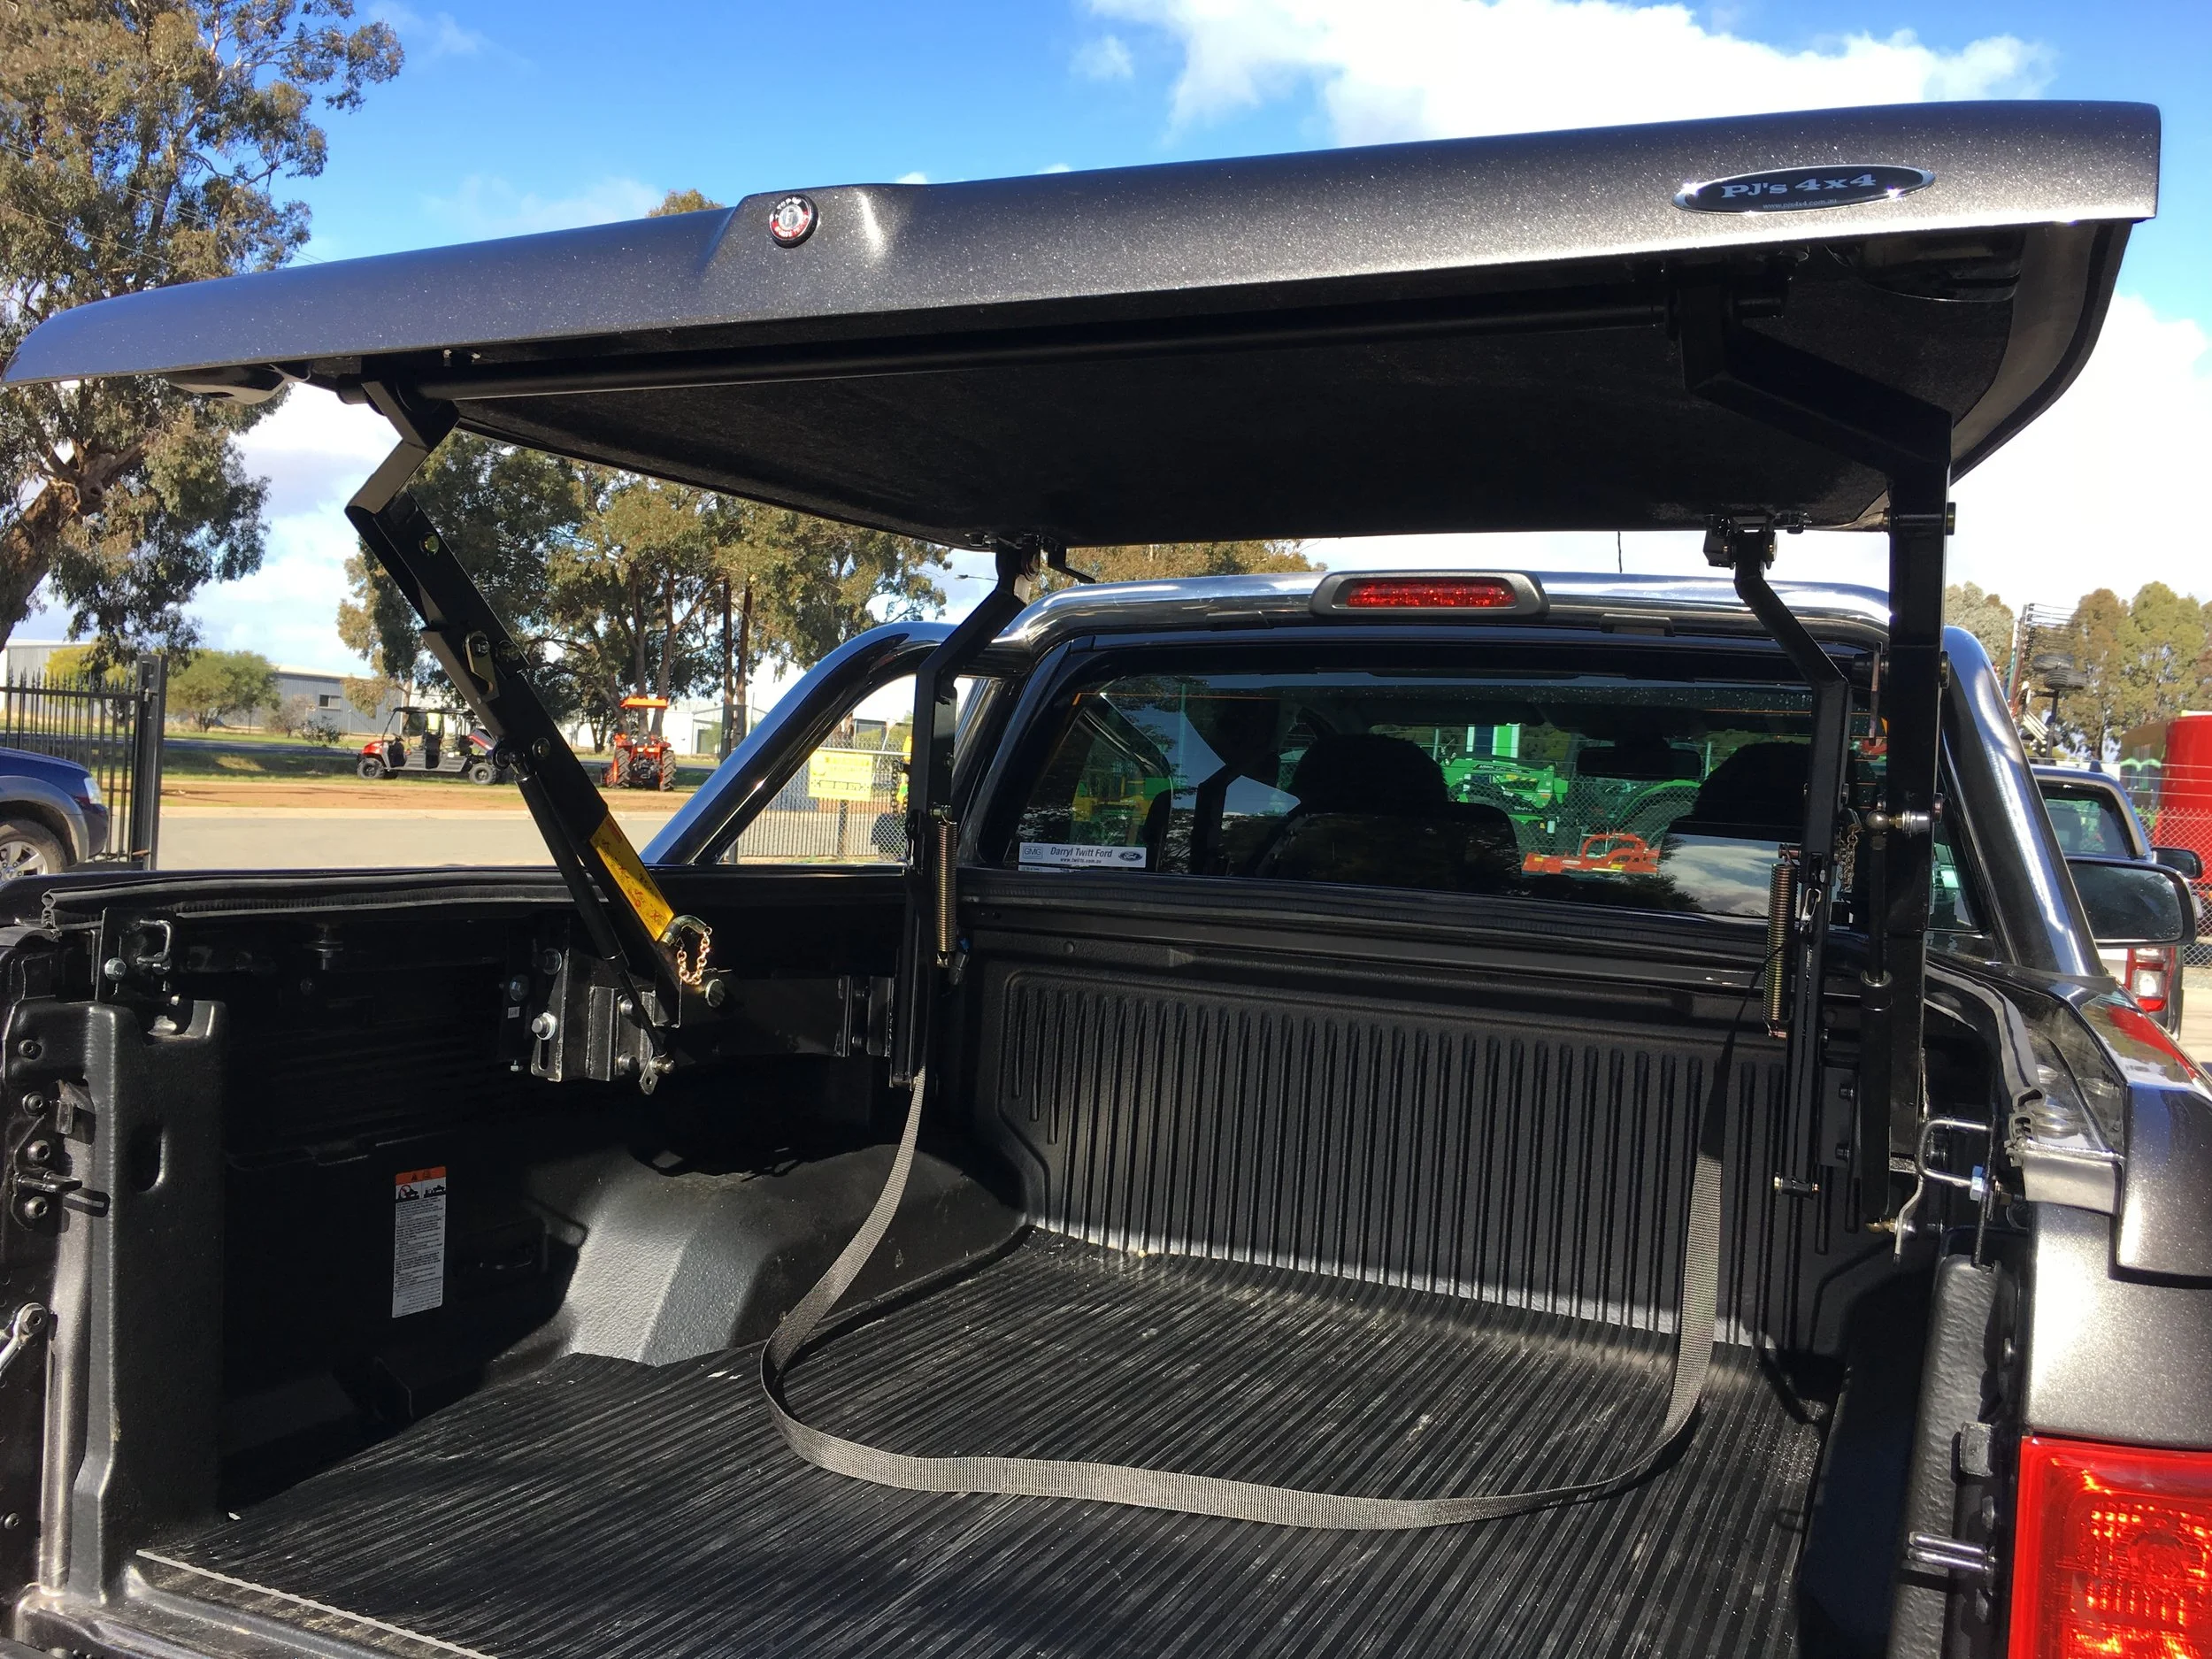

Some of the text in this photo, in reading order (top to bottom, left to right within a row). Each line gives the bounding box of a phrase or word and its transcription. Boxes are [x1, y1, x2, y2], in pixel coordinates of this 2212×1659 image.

[1721, 174, 1877, 198] PJ's 4x4
[1763, 198, 1837, 210] www.pjs4x4.com.au
[1049, 847, 1072, 857] Darryl
[1075, 848, 1094, 856] Twitt
